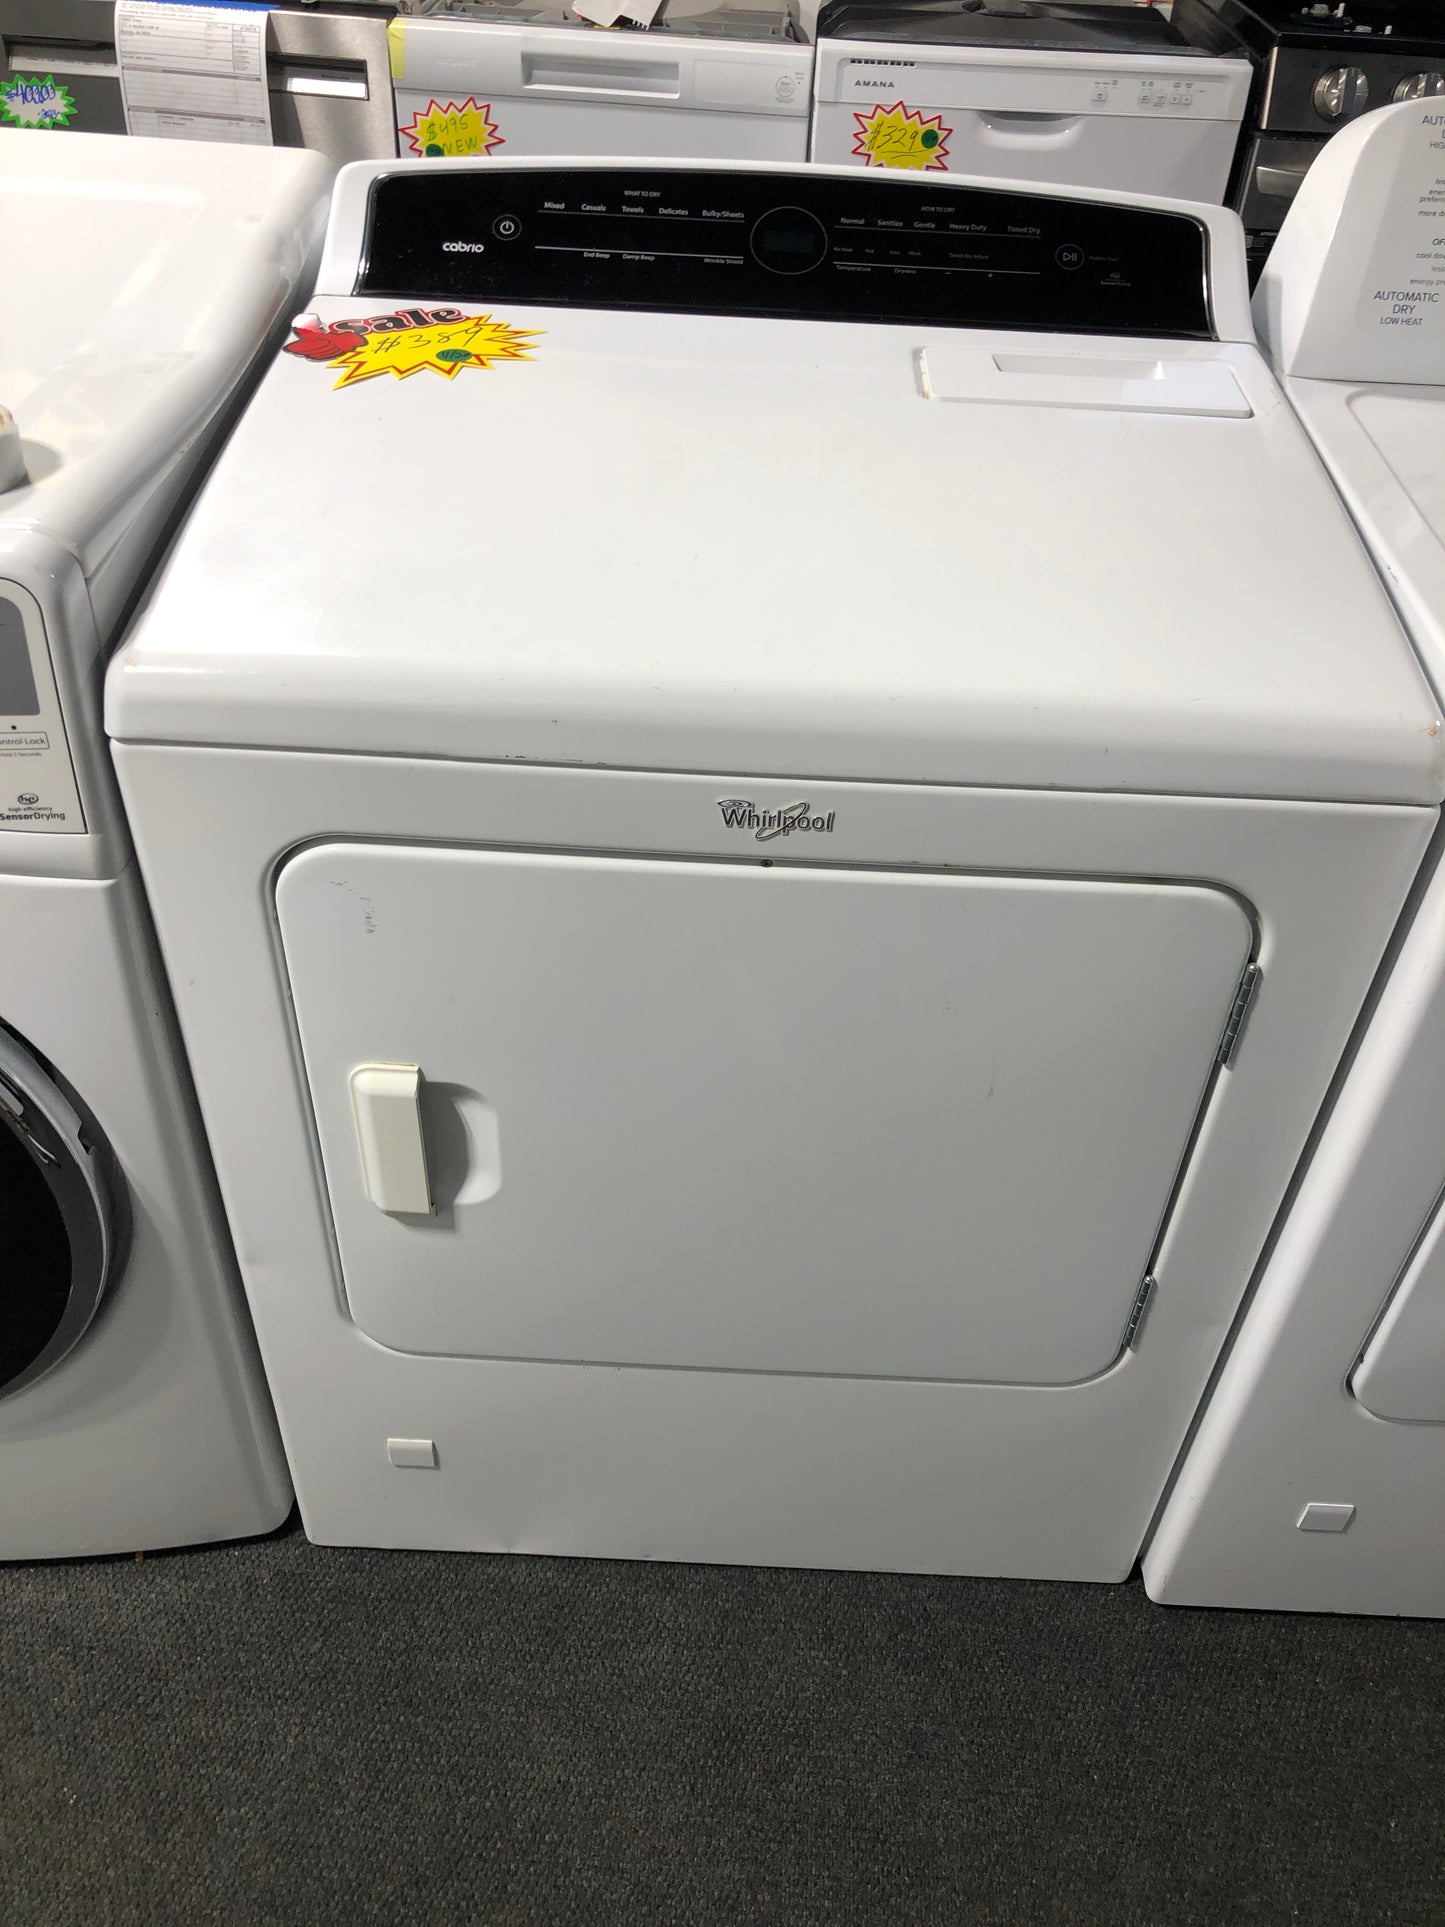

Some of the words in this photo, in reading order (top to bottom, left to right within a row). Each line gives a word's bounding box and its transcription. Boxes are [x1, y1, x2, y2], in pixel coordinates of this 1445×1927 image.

[854, 79, 895, 88] AMANA
[426, 113, 469, 142] $495
[442, 136, 478, 155] NEW
[543, 201, 566, 210] Mixed
[581, 203, 607, 212] Casuals
[622, 205, 645, 214] Towels
[658, 207, 689, 216] Delicates
[702, 209, 745, 219] Bulky/Sheets
[840, 217, 865, 226] Normal
[877, 219, 904, 228] Sanitize
[913, 221, 936, 229] Gentle
[949, 223, 970, 231] Heavy
[970, 223, 988, 232] Duty
[1028, 226, 1041, 235] Dry
[442, 241, 485, 253] cabrio
[595, 252, 610, 260] Beep
[1373, 290, 1440, 303] AUTOMATIC
[1392, 303, 1417, 315] DRY
[1380, 316, 1399, 325] LOW
[1400, 317, 1424, 326] HEAT
[25, 737, 46, 745] Lock
[0, 811, 66, 821] SensorDrying
[719, 804, 835, 837] Whirlpool
